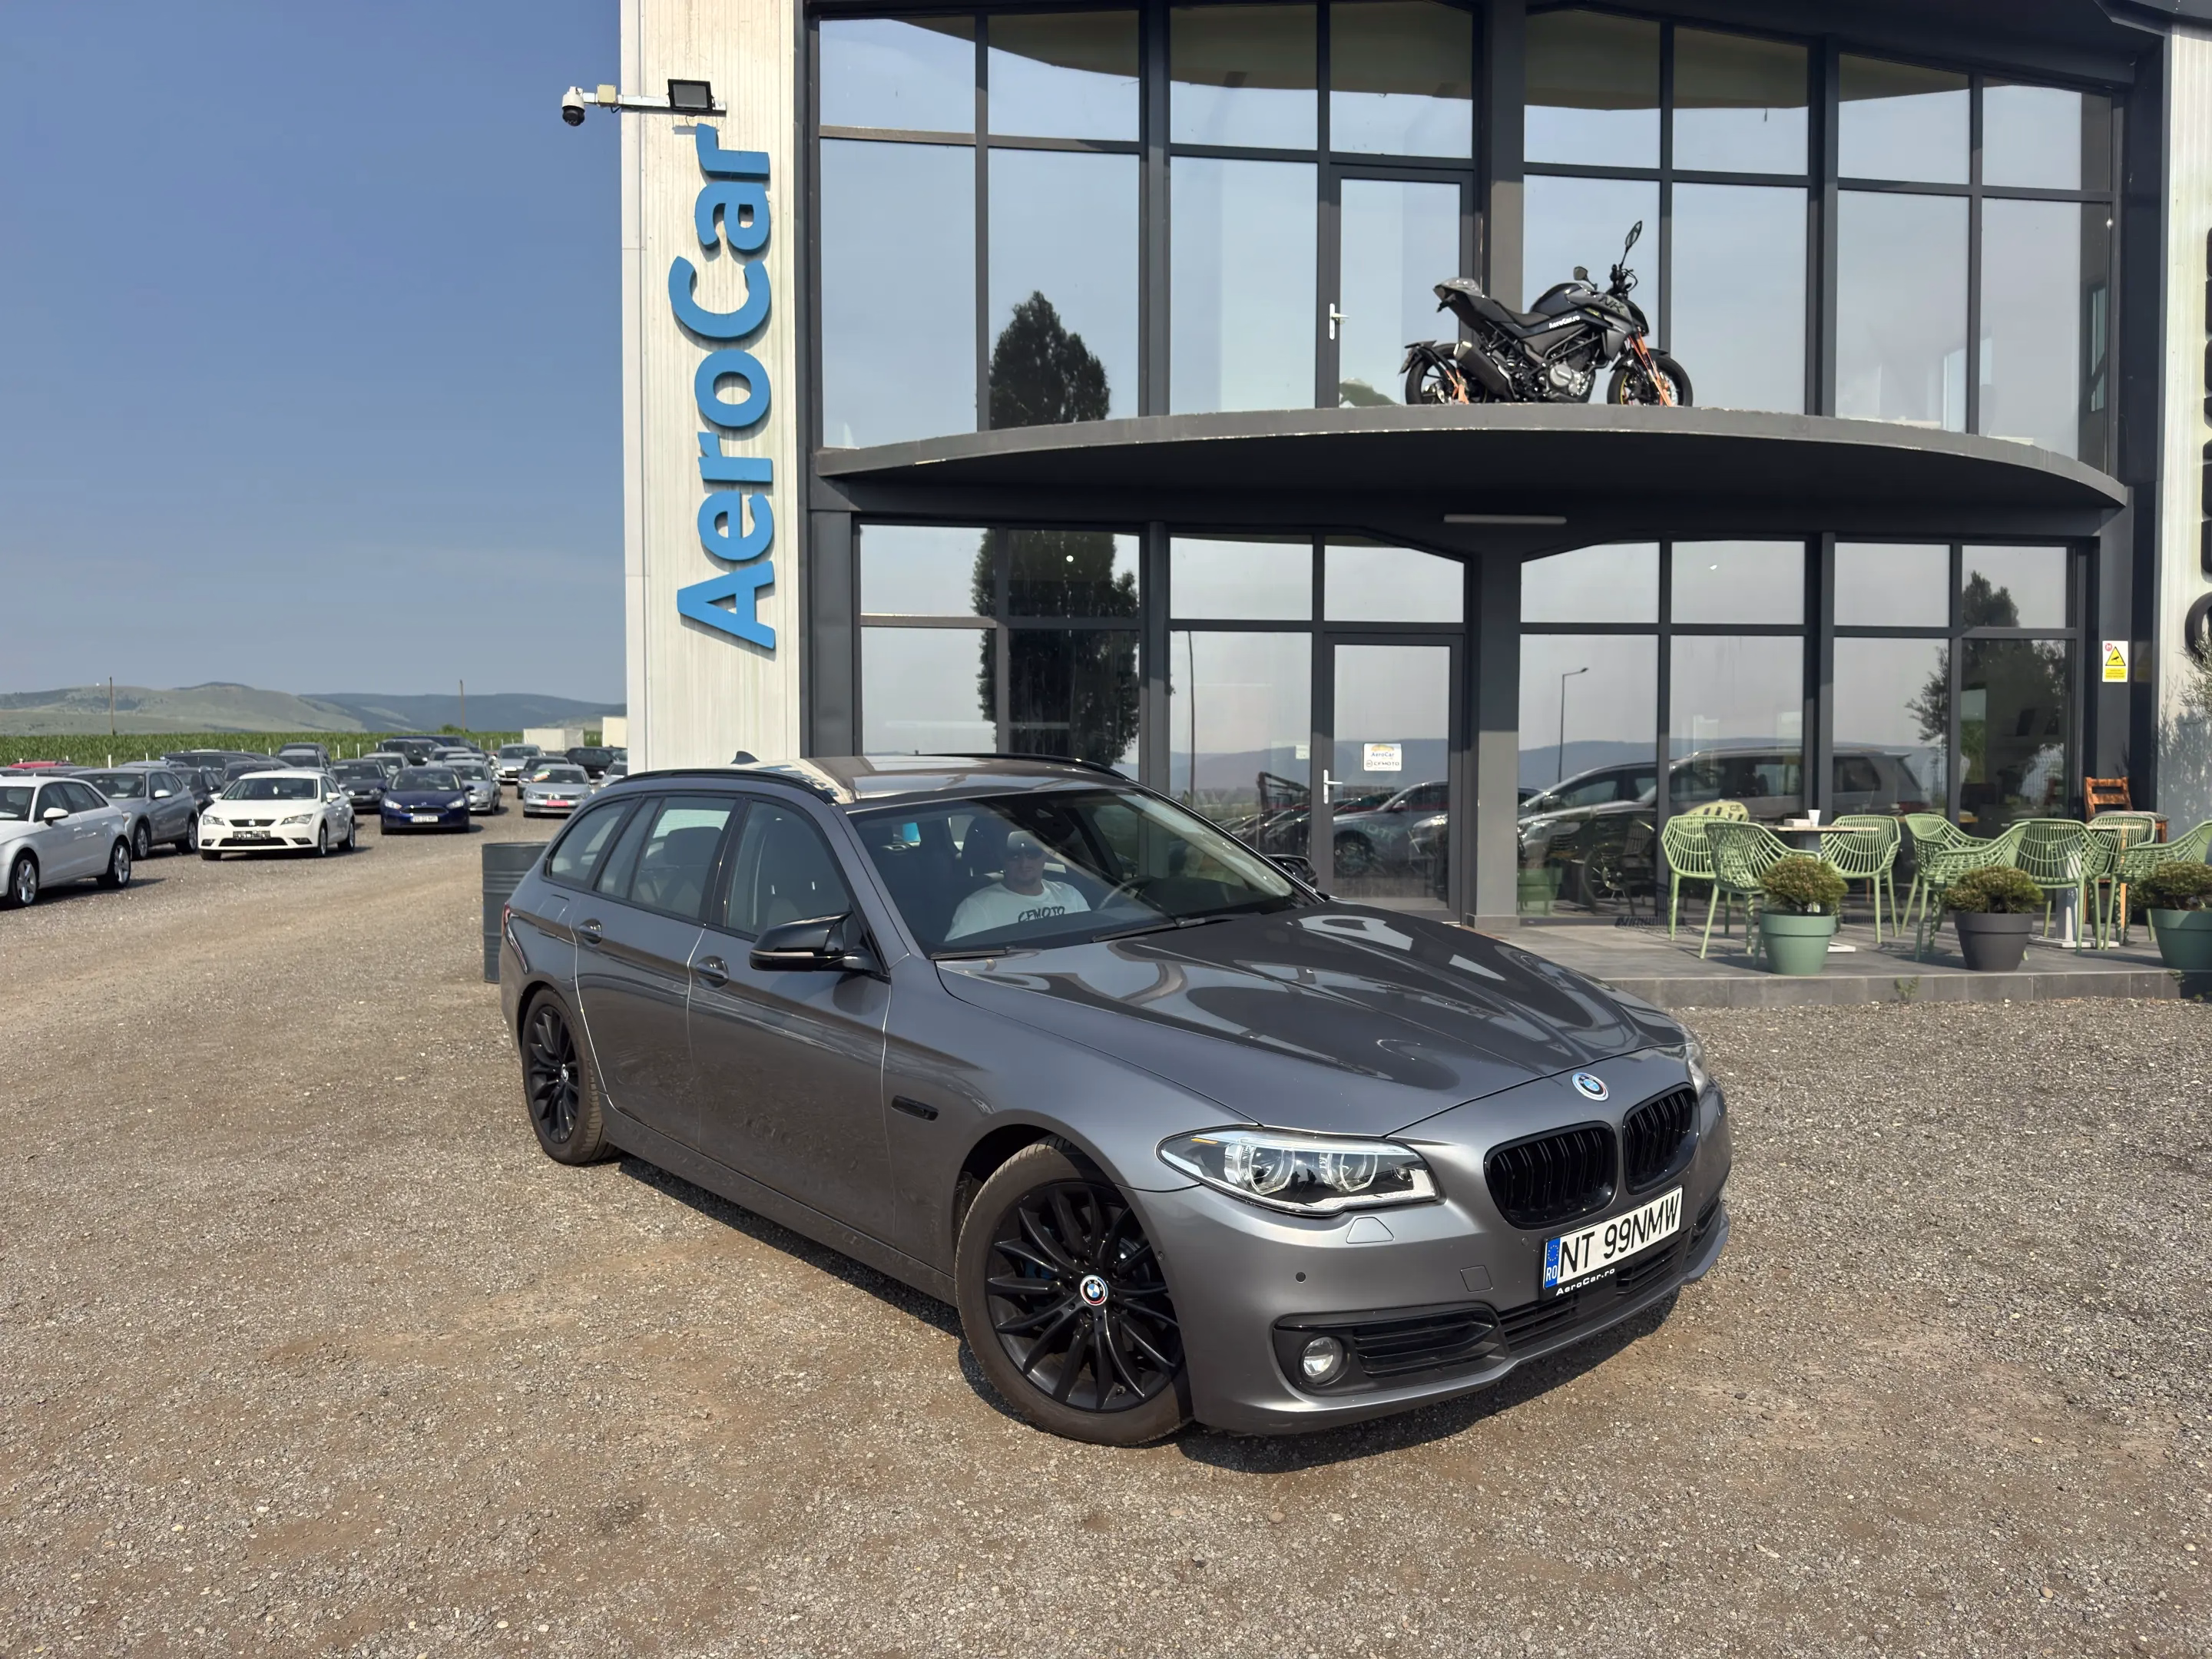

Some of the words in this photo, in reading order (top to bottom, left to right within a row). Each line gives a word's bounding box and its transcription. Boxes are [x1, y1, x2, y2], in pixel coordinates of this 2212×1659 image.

[668, 123, 775, 650] AeroCar
[1559, 1231, 1595, 1277] NT
[1603, 1192, 1681, 1260] 99NMW
[1545, 1264, 1558, 1282] RO
[1555, 1268, 1616, 1296] AeroCar.ro
